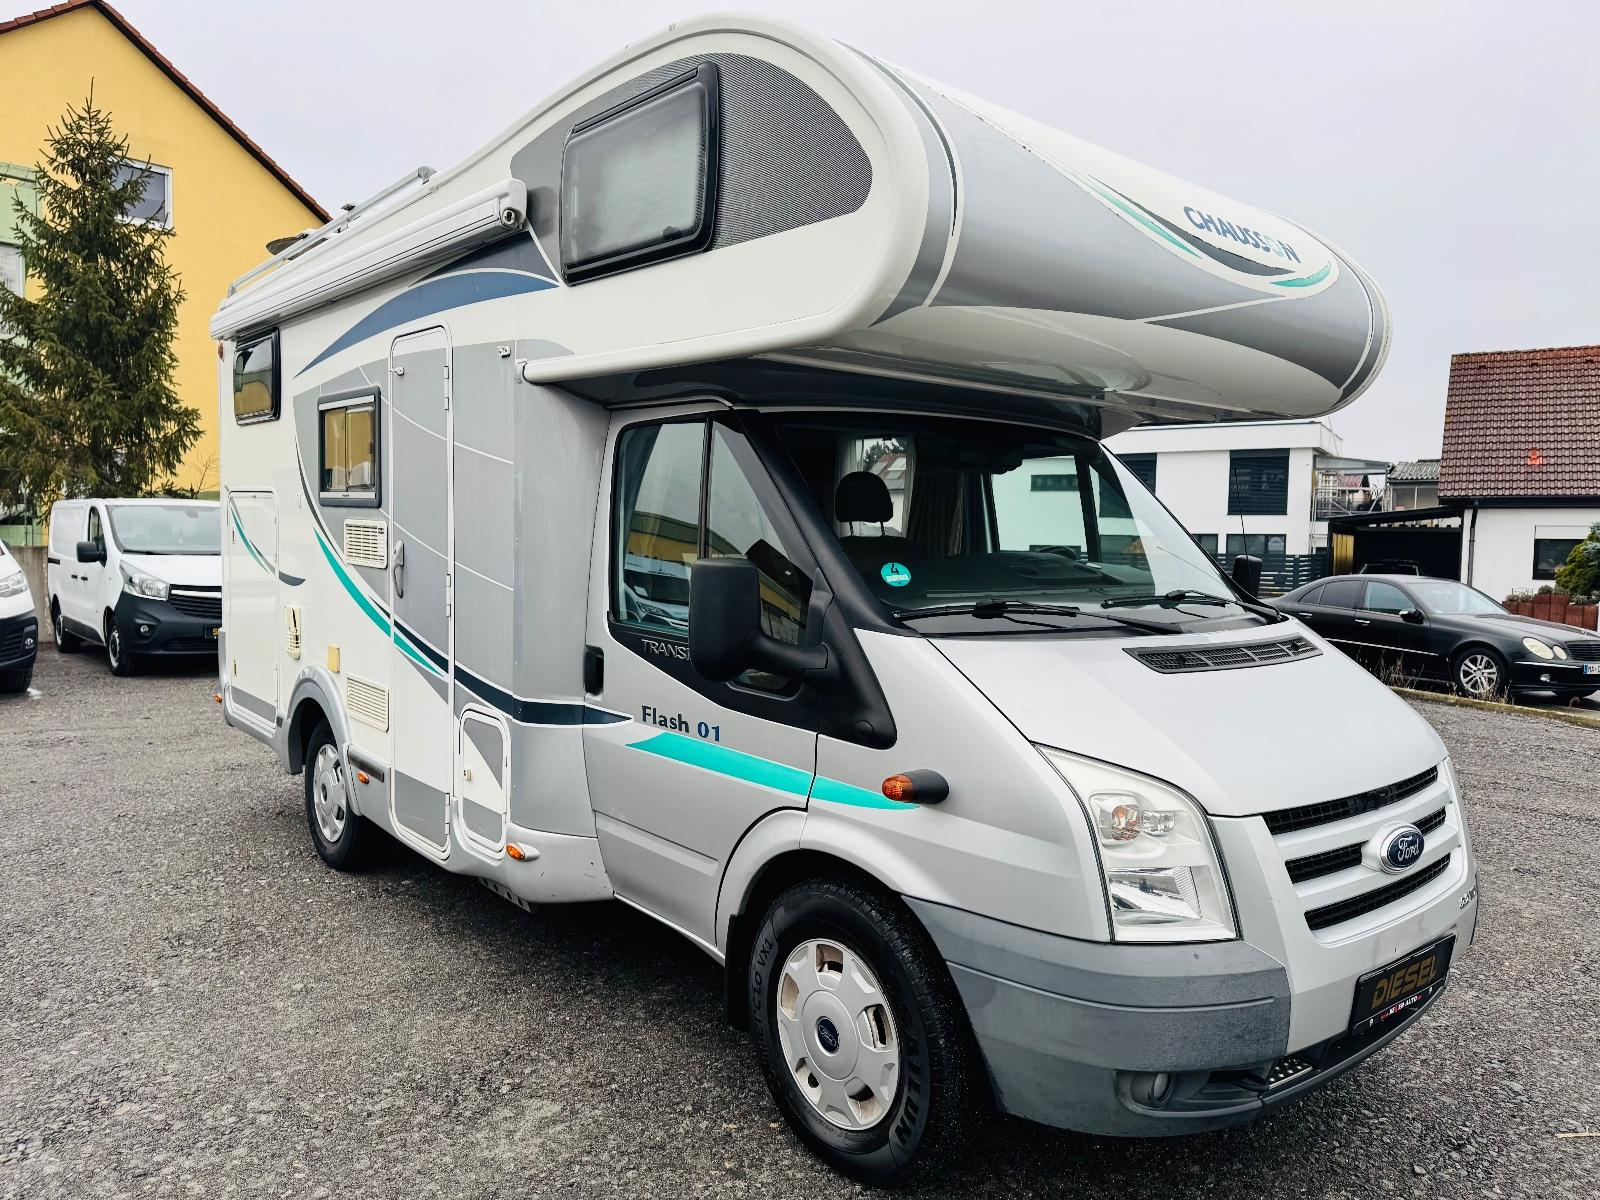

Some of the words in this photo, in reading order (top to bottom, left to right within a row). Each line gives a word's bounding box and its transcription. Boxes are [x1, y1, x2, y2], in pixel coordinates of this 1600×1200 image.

[1183, 206, 1301, 264] CHAUSSON
[891, 563, 900, 575] 4
[641, 639, 690, 661] TRANSI
[641, 705, 690, 734] Flash
[697, 721, 720, 742] 01
[1397, 835, 1419, 862] Ford
[1371, 954, 1437, 1009] DIESEL
